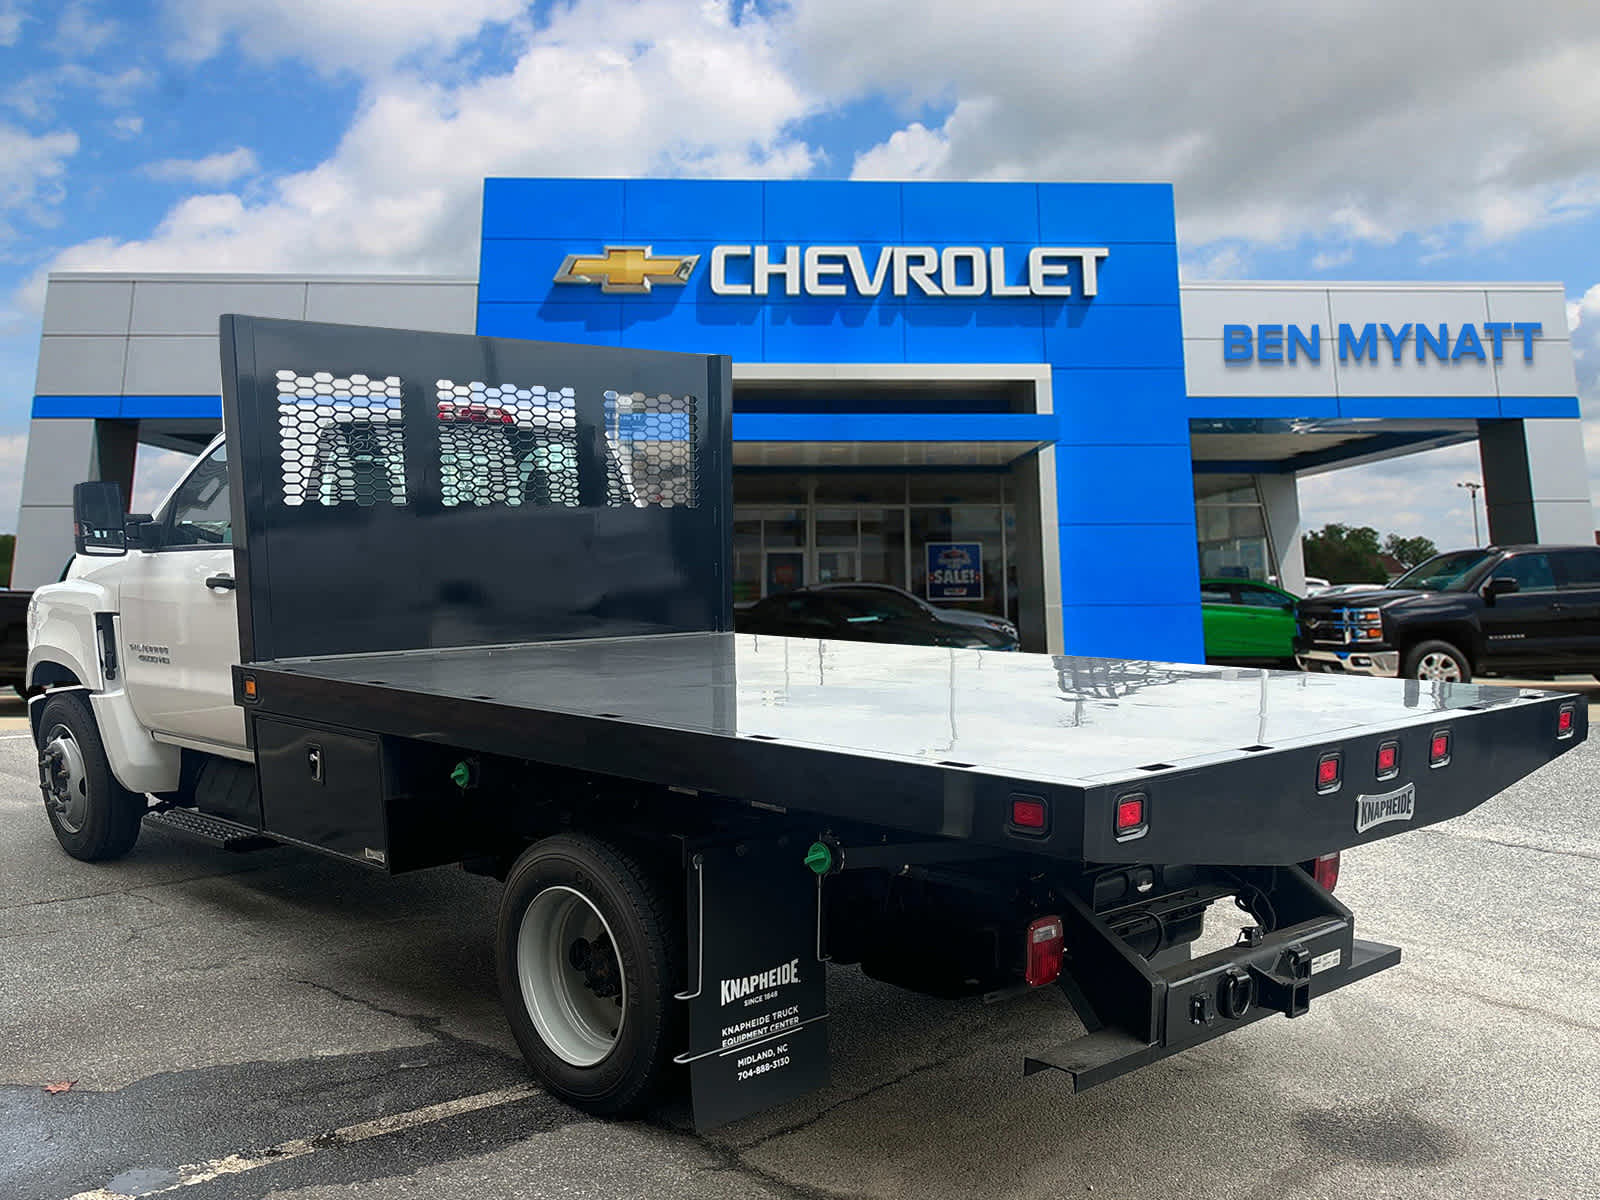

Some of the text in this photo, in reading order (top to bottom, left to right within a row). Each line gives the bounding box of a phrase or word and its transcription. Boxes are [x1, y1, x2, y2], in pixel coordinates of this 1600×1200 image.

[709, 245, 1110, 297] CHEVROLET
[1223, 322, 1542, 362] BEN MYNATT
[934, 569, 975, 585] SALE!
[1361, 789, 1413, 828] KNAPHEIDE
[720, 958, 800, 1007] KNAPHEIDE
[743, 994, 763, 1007] SINCE
[721, 1005, 799, 1037] KNAPHEIDE TRUCK
[722, 1016, 800, 1049] EQUIPMENT CENTER
[737, 1043, 789, 1068] MIDLAND, NC
[737, 1056, 790, 1081] 704-888-3130
